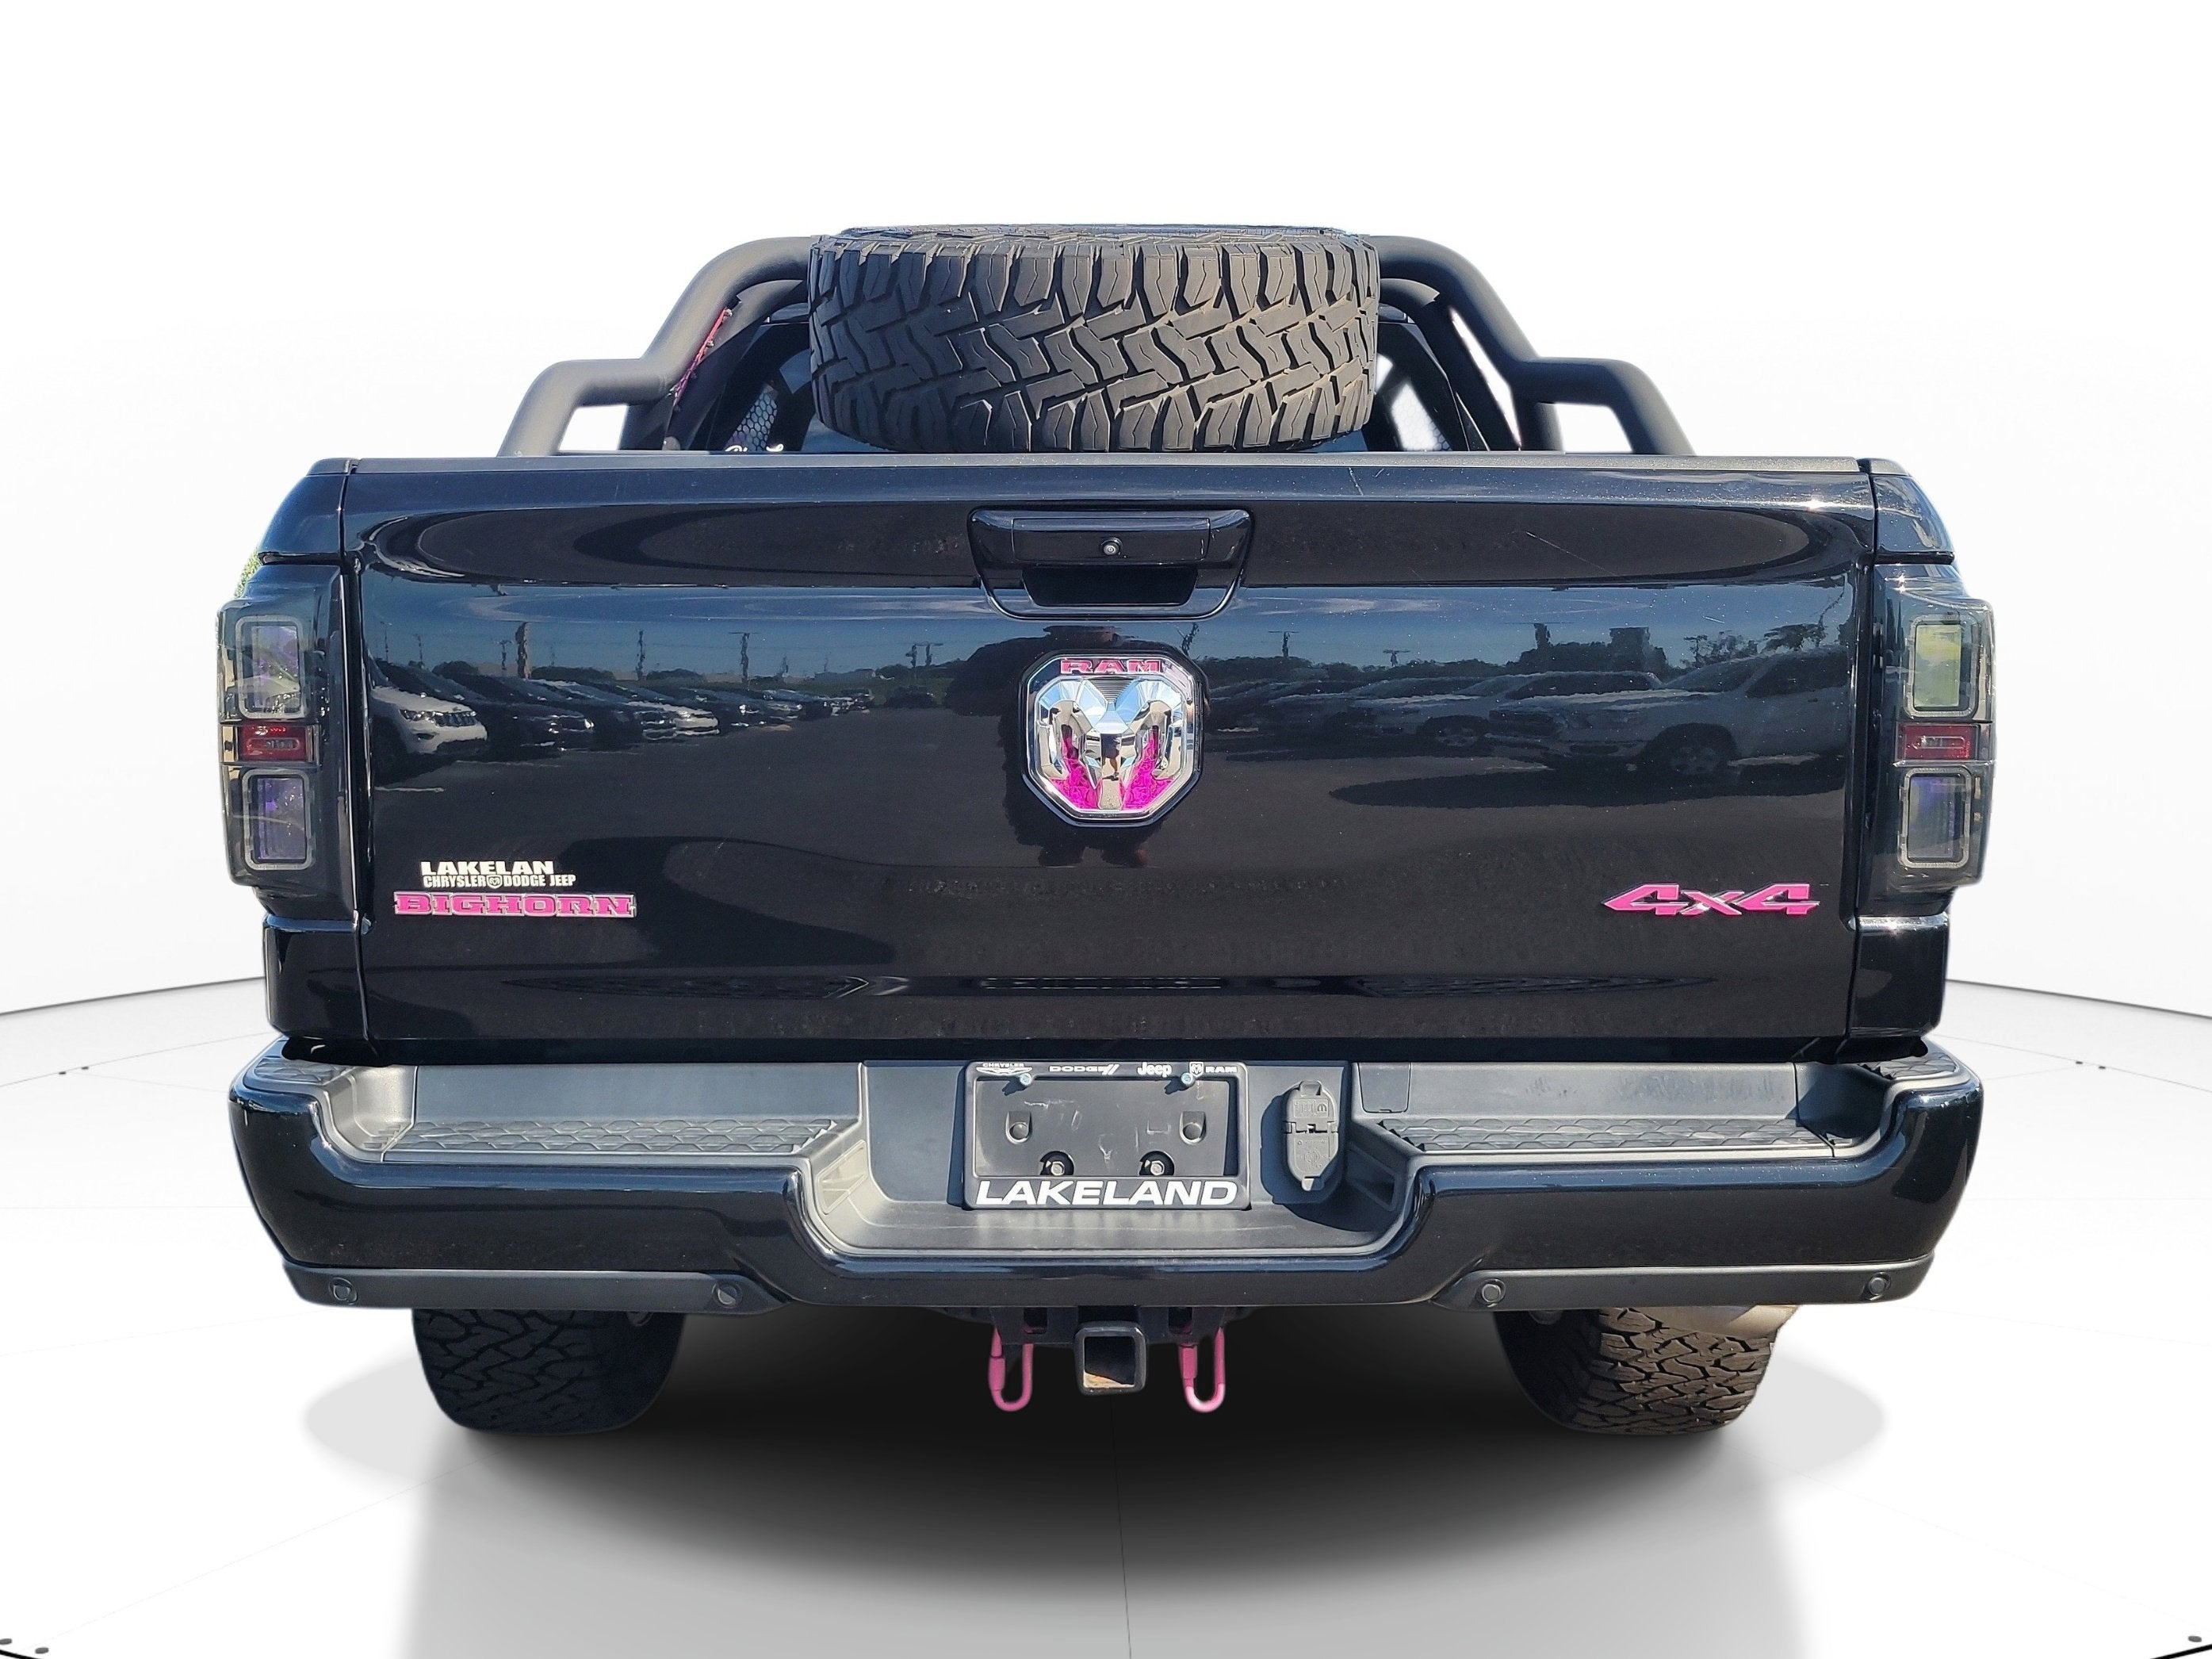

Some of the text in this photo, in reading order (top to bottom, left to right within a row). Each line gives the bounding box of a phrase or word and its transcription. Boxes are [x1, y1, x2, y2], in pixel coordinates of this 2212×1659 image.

[1061, 659, 1161, 674] RAM
[420, 860, 554, 875] LAKELAN
[423, 874, 576, 887] CHRYSLER DODGE JEEP
[393, 891, 636, 918] BIGHORN
[1137, 1061, 1173, 1078] Jeep
[975, 1179, 1238, 1205] LAKELAND
